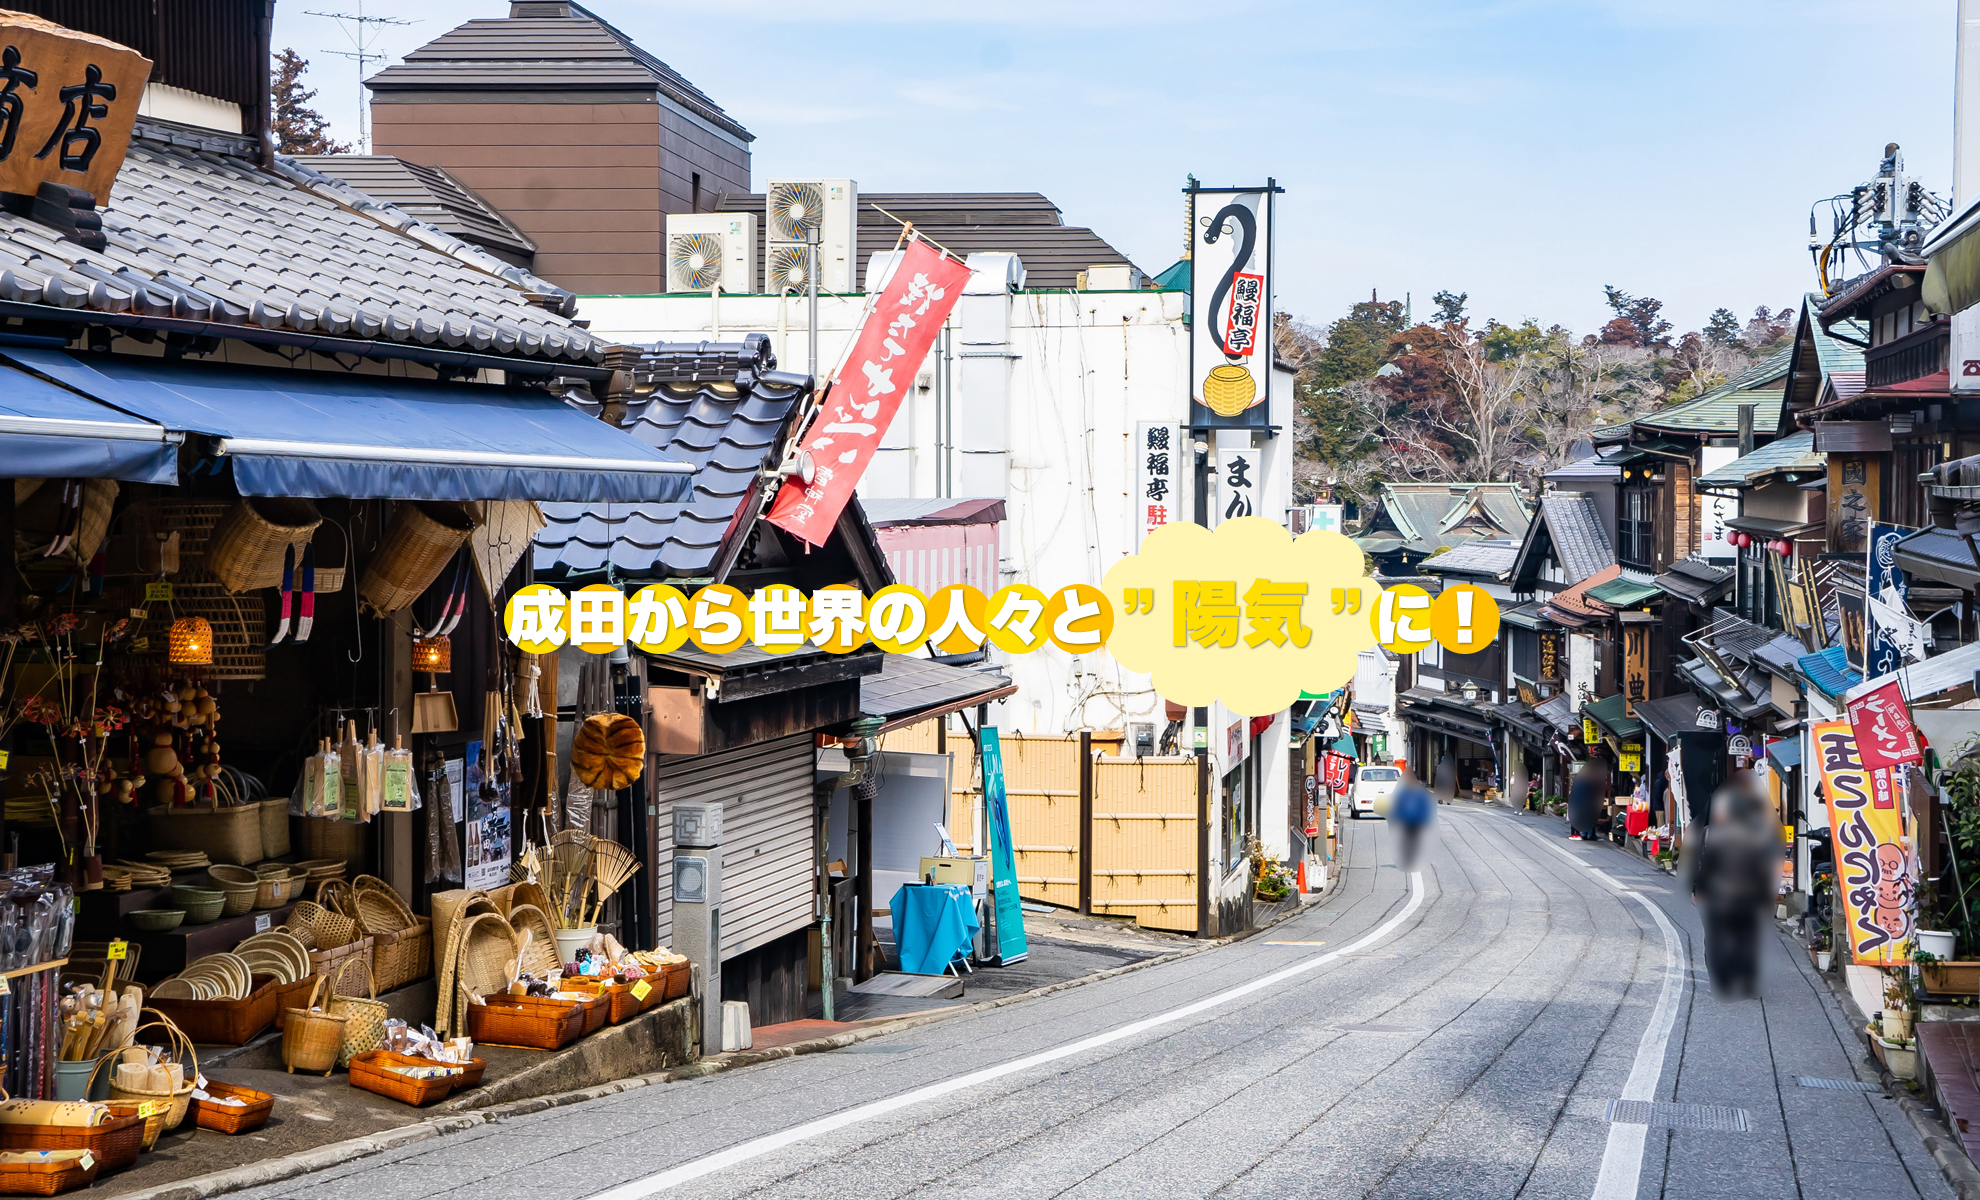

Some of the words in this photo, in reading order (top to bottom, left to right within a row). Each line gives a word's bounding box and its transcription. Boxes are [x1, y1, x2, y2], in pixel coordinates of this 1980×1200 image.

[1228, 278, 1259, 350] 鰻福亭
[1627, 628, 1646, 716] 川豊
